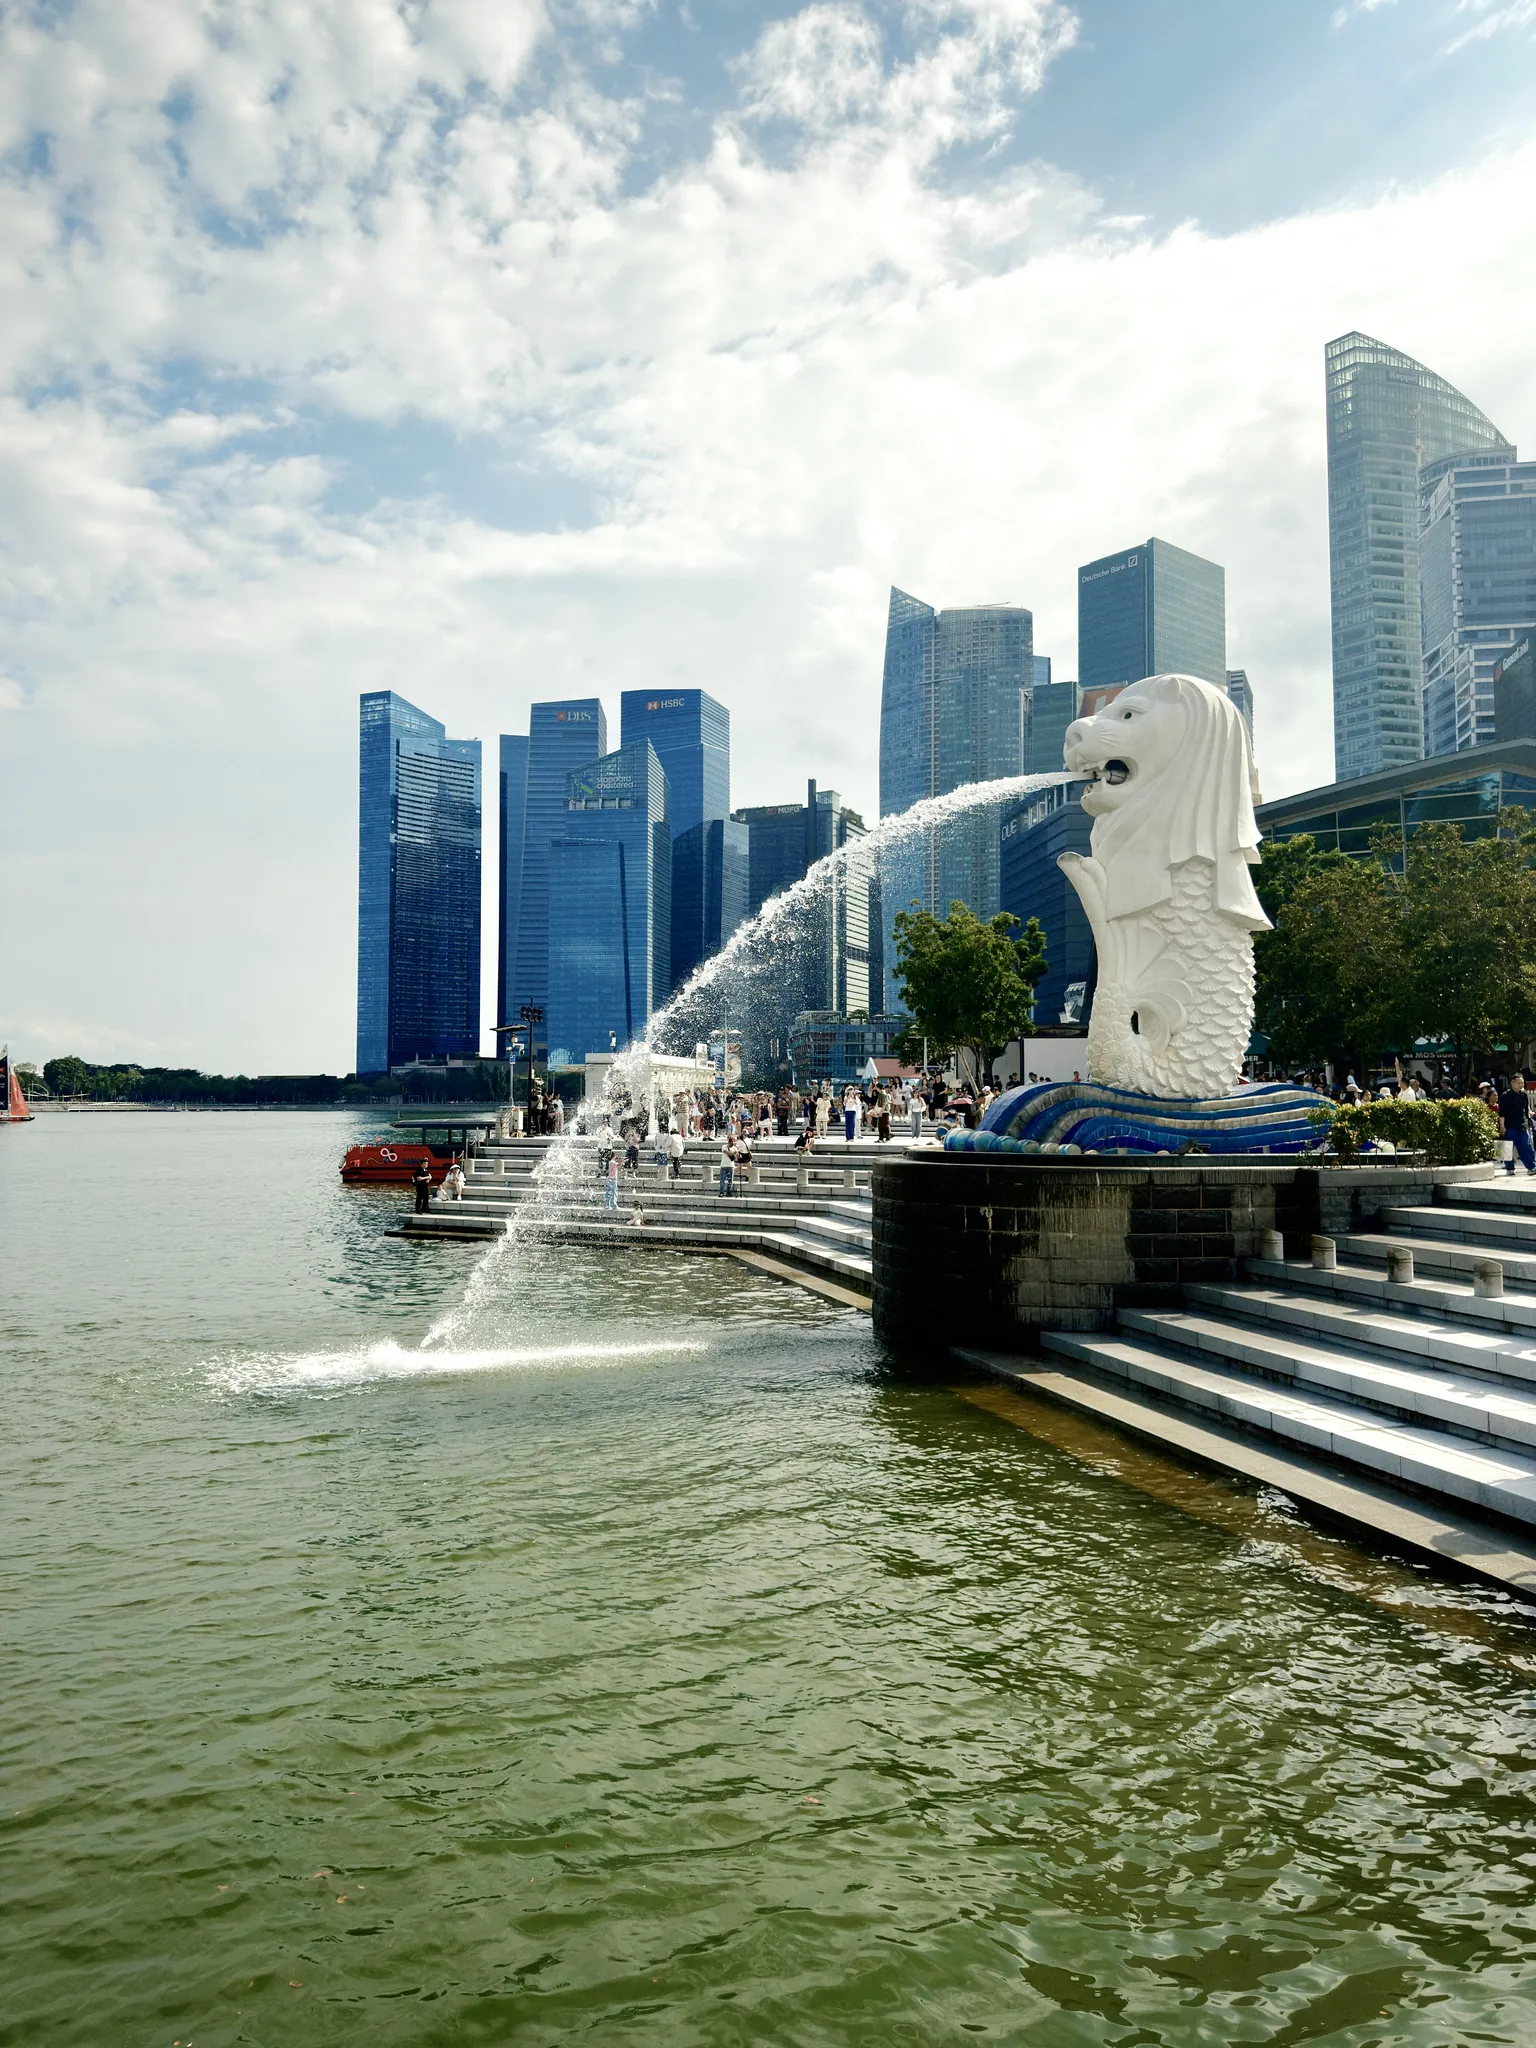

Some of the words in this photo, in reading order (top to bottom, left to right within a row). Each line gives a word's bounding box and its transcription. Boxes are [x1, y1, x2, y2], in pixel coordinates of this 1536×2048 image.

[1081, 570, 1110, 584] Deutsche
[1110, 563, 1127, 574] Bank
[661, 698, 685, 708] HSBC
[567, 711, 592, 721] DBS
